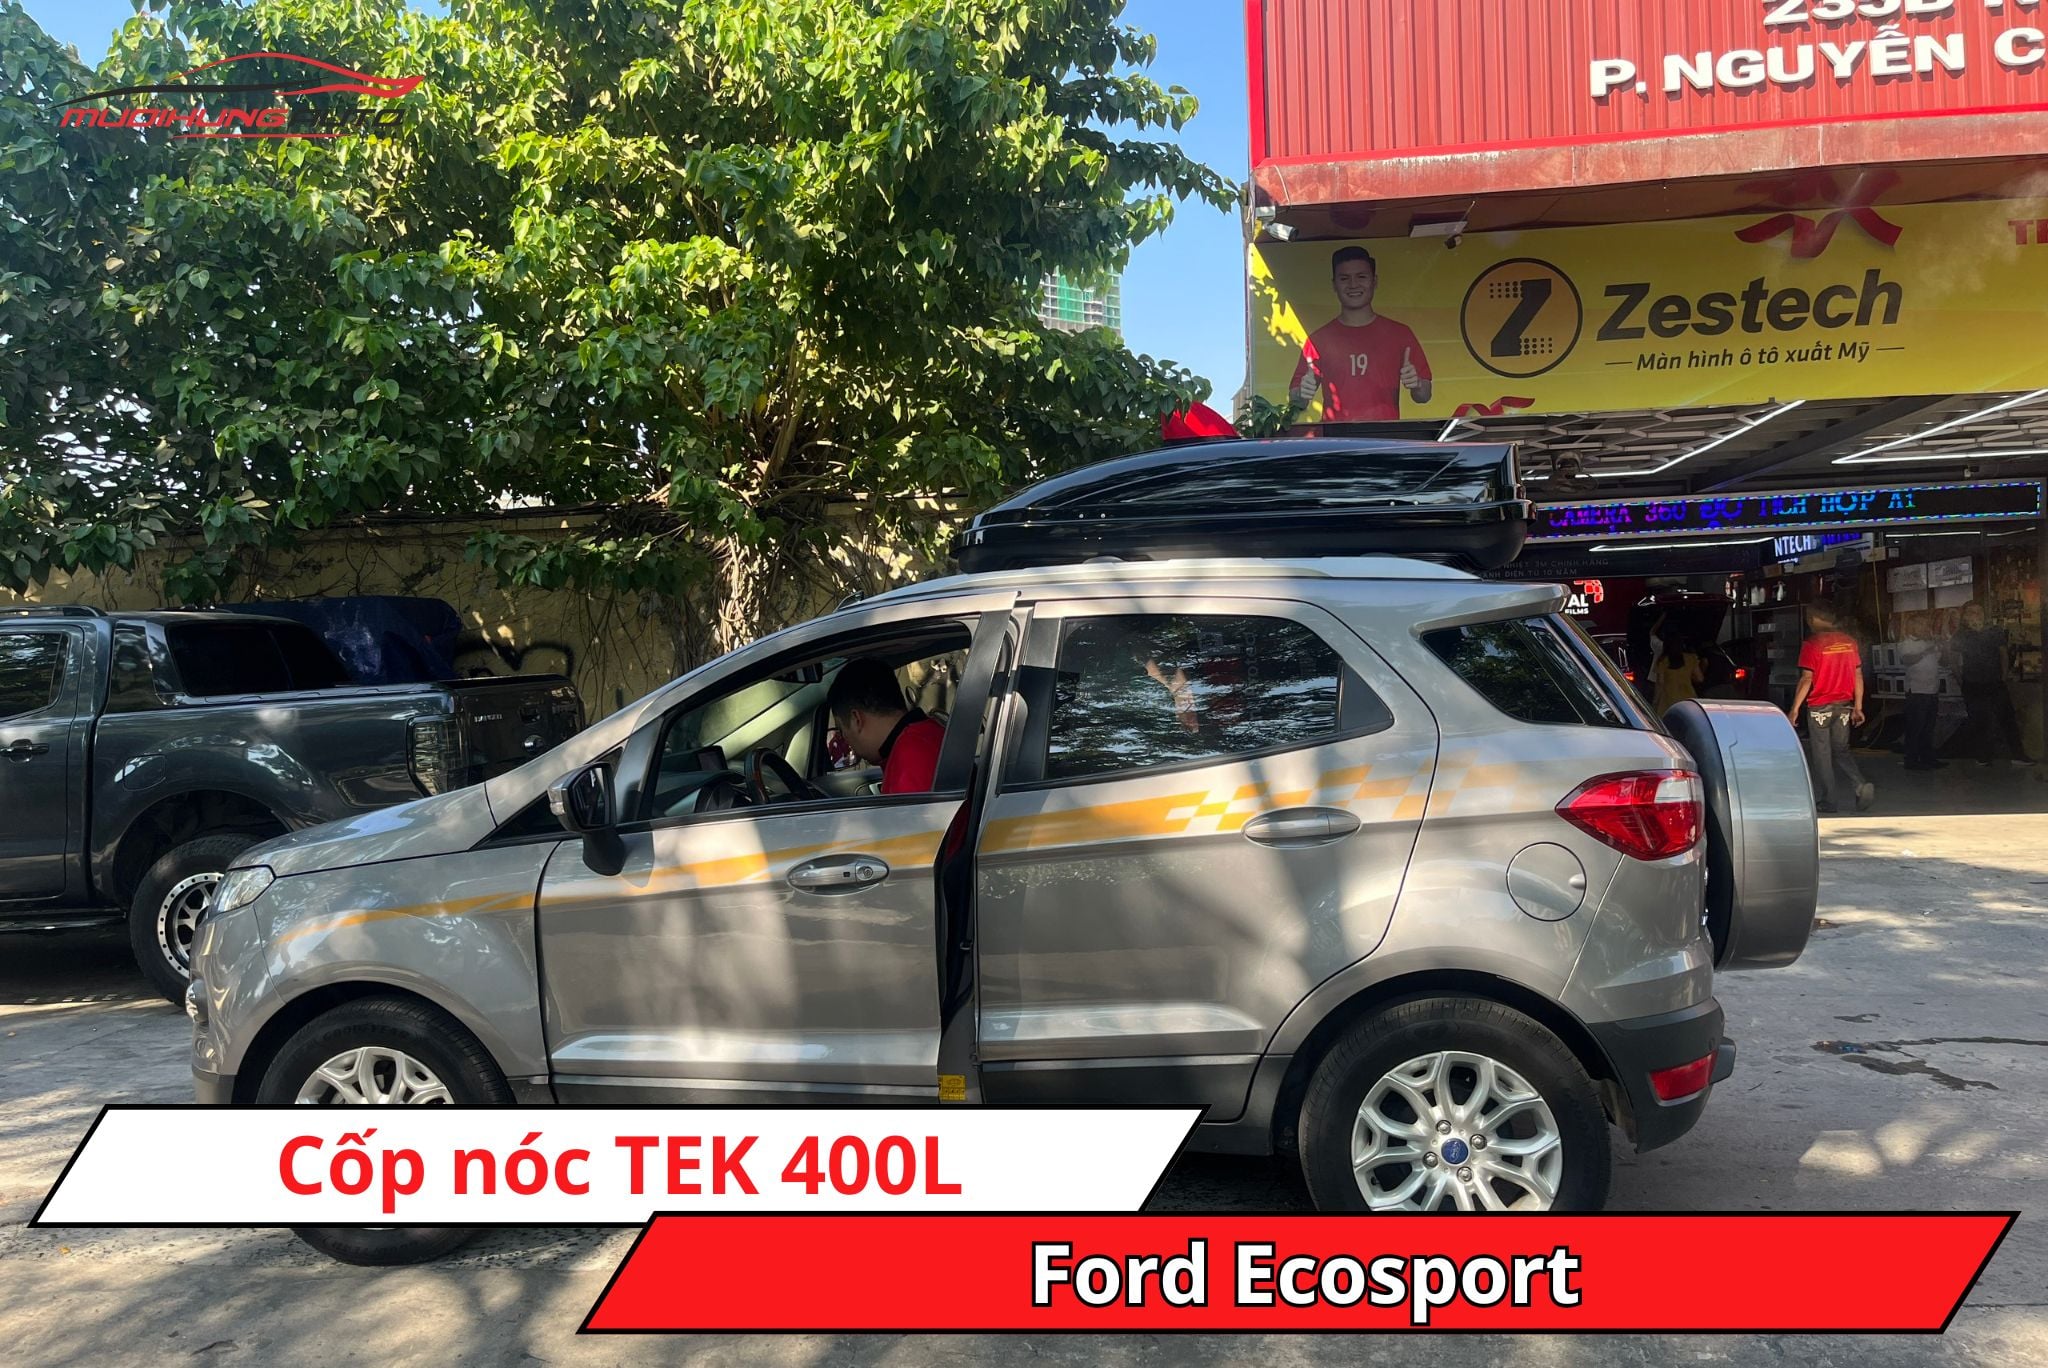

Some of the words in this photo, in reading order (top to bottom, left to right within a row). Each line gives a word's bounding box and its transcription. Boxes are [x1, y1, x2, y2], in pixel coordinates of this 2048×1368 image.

[1590, 58, 1647, 98] P.
[1663, 23, 1965, 93] NGUYỄN
[1596, 269, 1903, 342] Zestech
[1349, 353, 1368, 376] 19
[1636, 353, 1682, 371] Màn
[1688, 348, 1733, 368] hình
[1739, 348, 1752, 366] ô
[1758, 346, 1780, 365] tô
[1785, 340, 1832, 363] xuất
[1837, 341, 1870, 362] Mỹ
